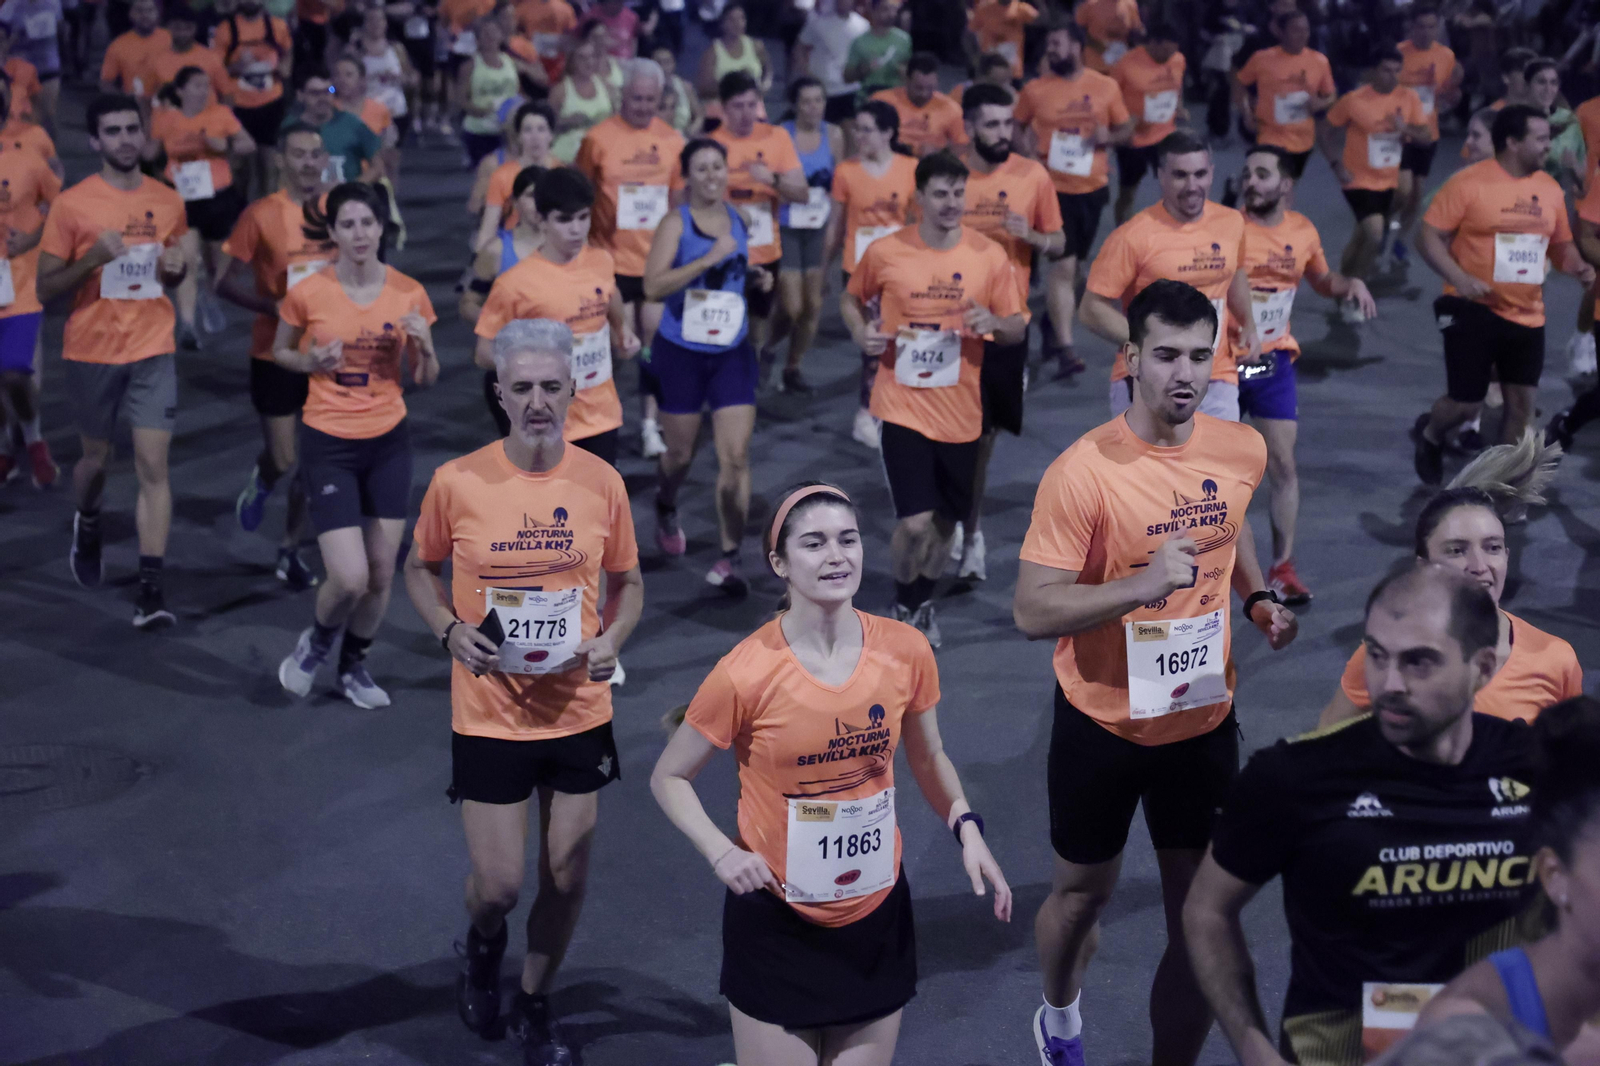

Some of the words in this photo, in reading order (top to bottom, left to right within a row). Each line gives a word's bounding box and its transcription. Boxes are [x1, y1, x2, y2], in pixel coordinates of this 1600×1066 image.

[911, 349, 944, 363] 9474
[1170, 501, 1228, 519] NOCTURNA
[516, 529, 574, 539] NOCTURNA
[490, 541, 543, 552] SEVILLA
[508, 617, 567, 640] 21778
[1155, 644, 1208, 676] 16972
[828, 728, 890, 749] NOCTURNA
[797, 748, 857, 766] SEVILLA
[802, 805, 828, 813] Sevilla
[818, 828, 881, 859] 11863
[1379, 846, 1421, 862] CLUB
[1424, 841, 1515, 860] DEPORTIVO
